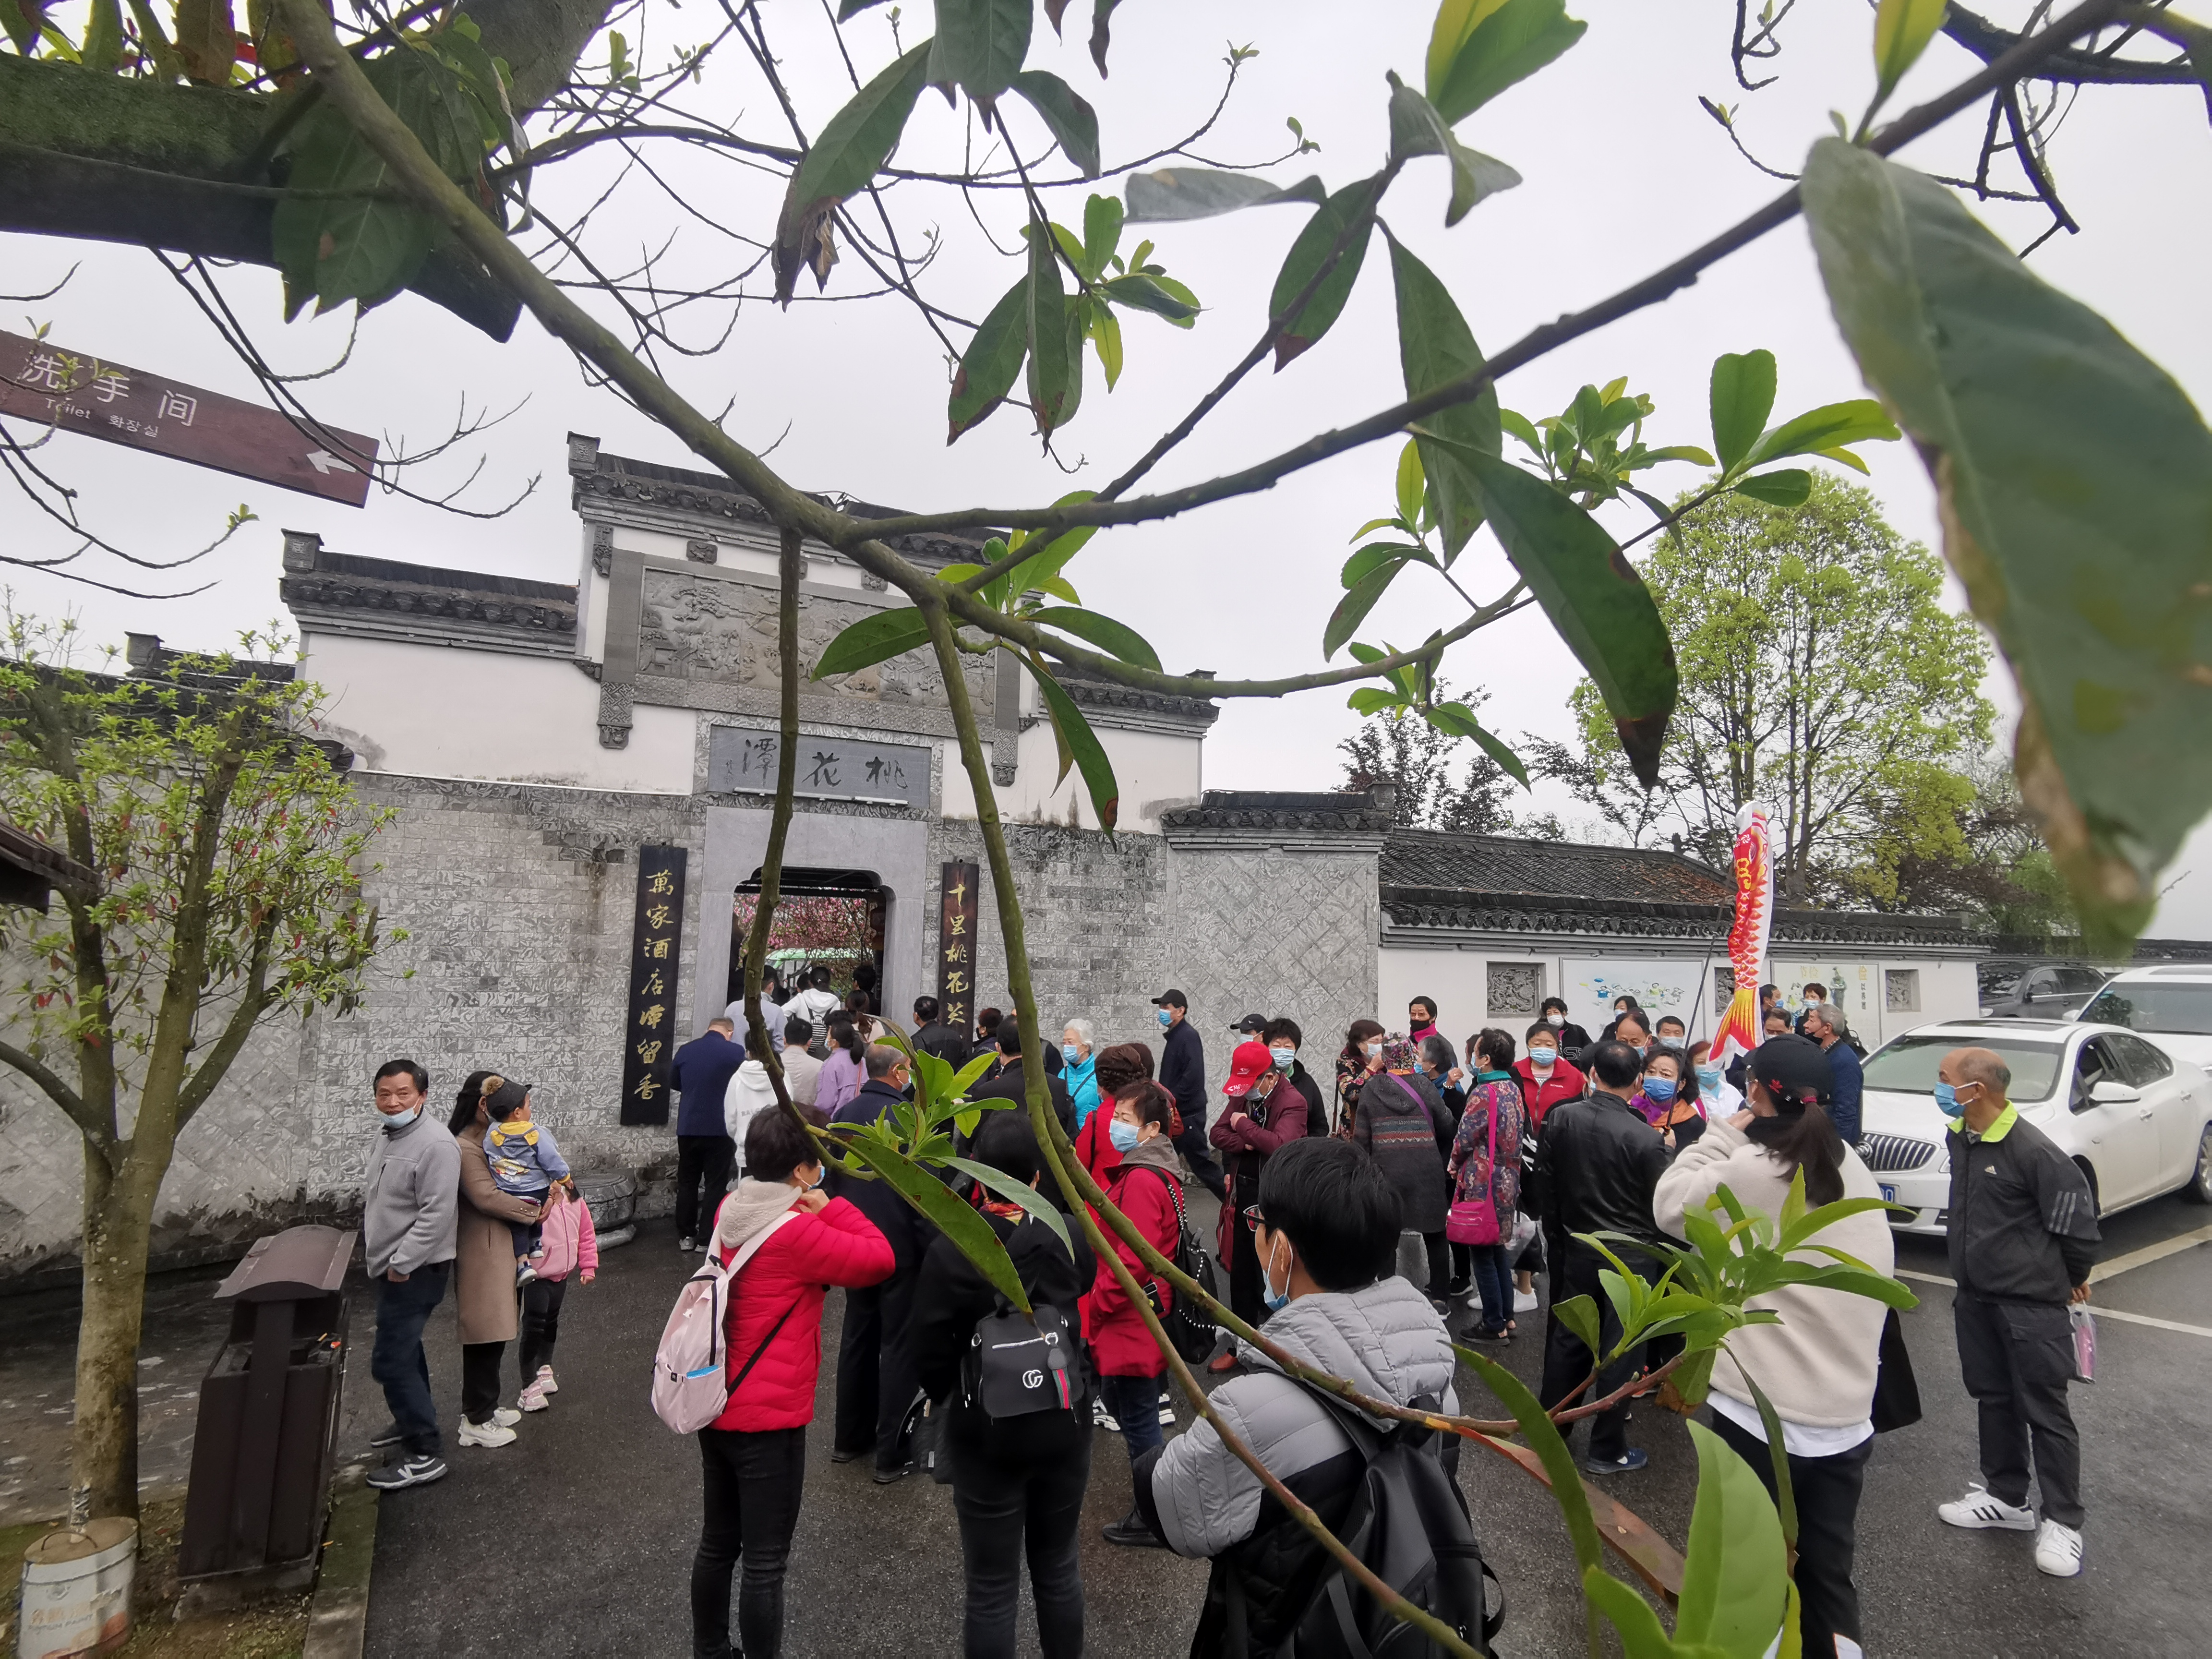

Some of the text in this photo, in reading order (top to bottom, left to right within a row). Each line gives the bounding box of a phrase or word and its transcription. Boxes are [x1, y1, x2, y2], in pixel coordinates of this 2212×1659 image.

[22, 354, 197, 426] 洗手间
[108, 414, 159, 438] 화장실
[743, 738, 908, 789] 桃花潭
[944, 883, 969, 1040] 十里桃花笑
